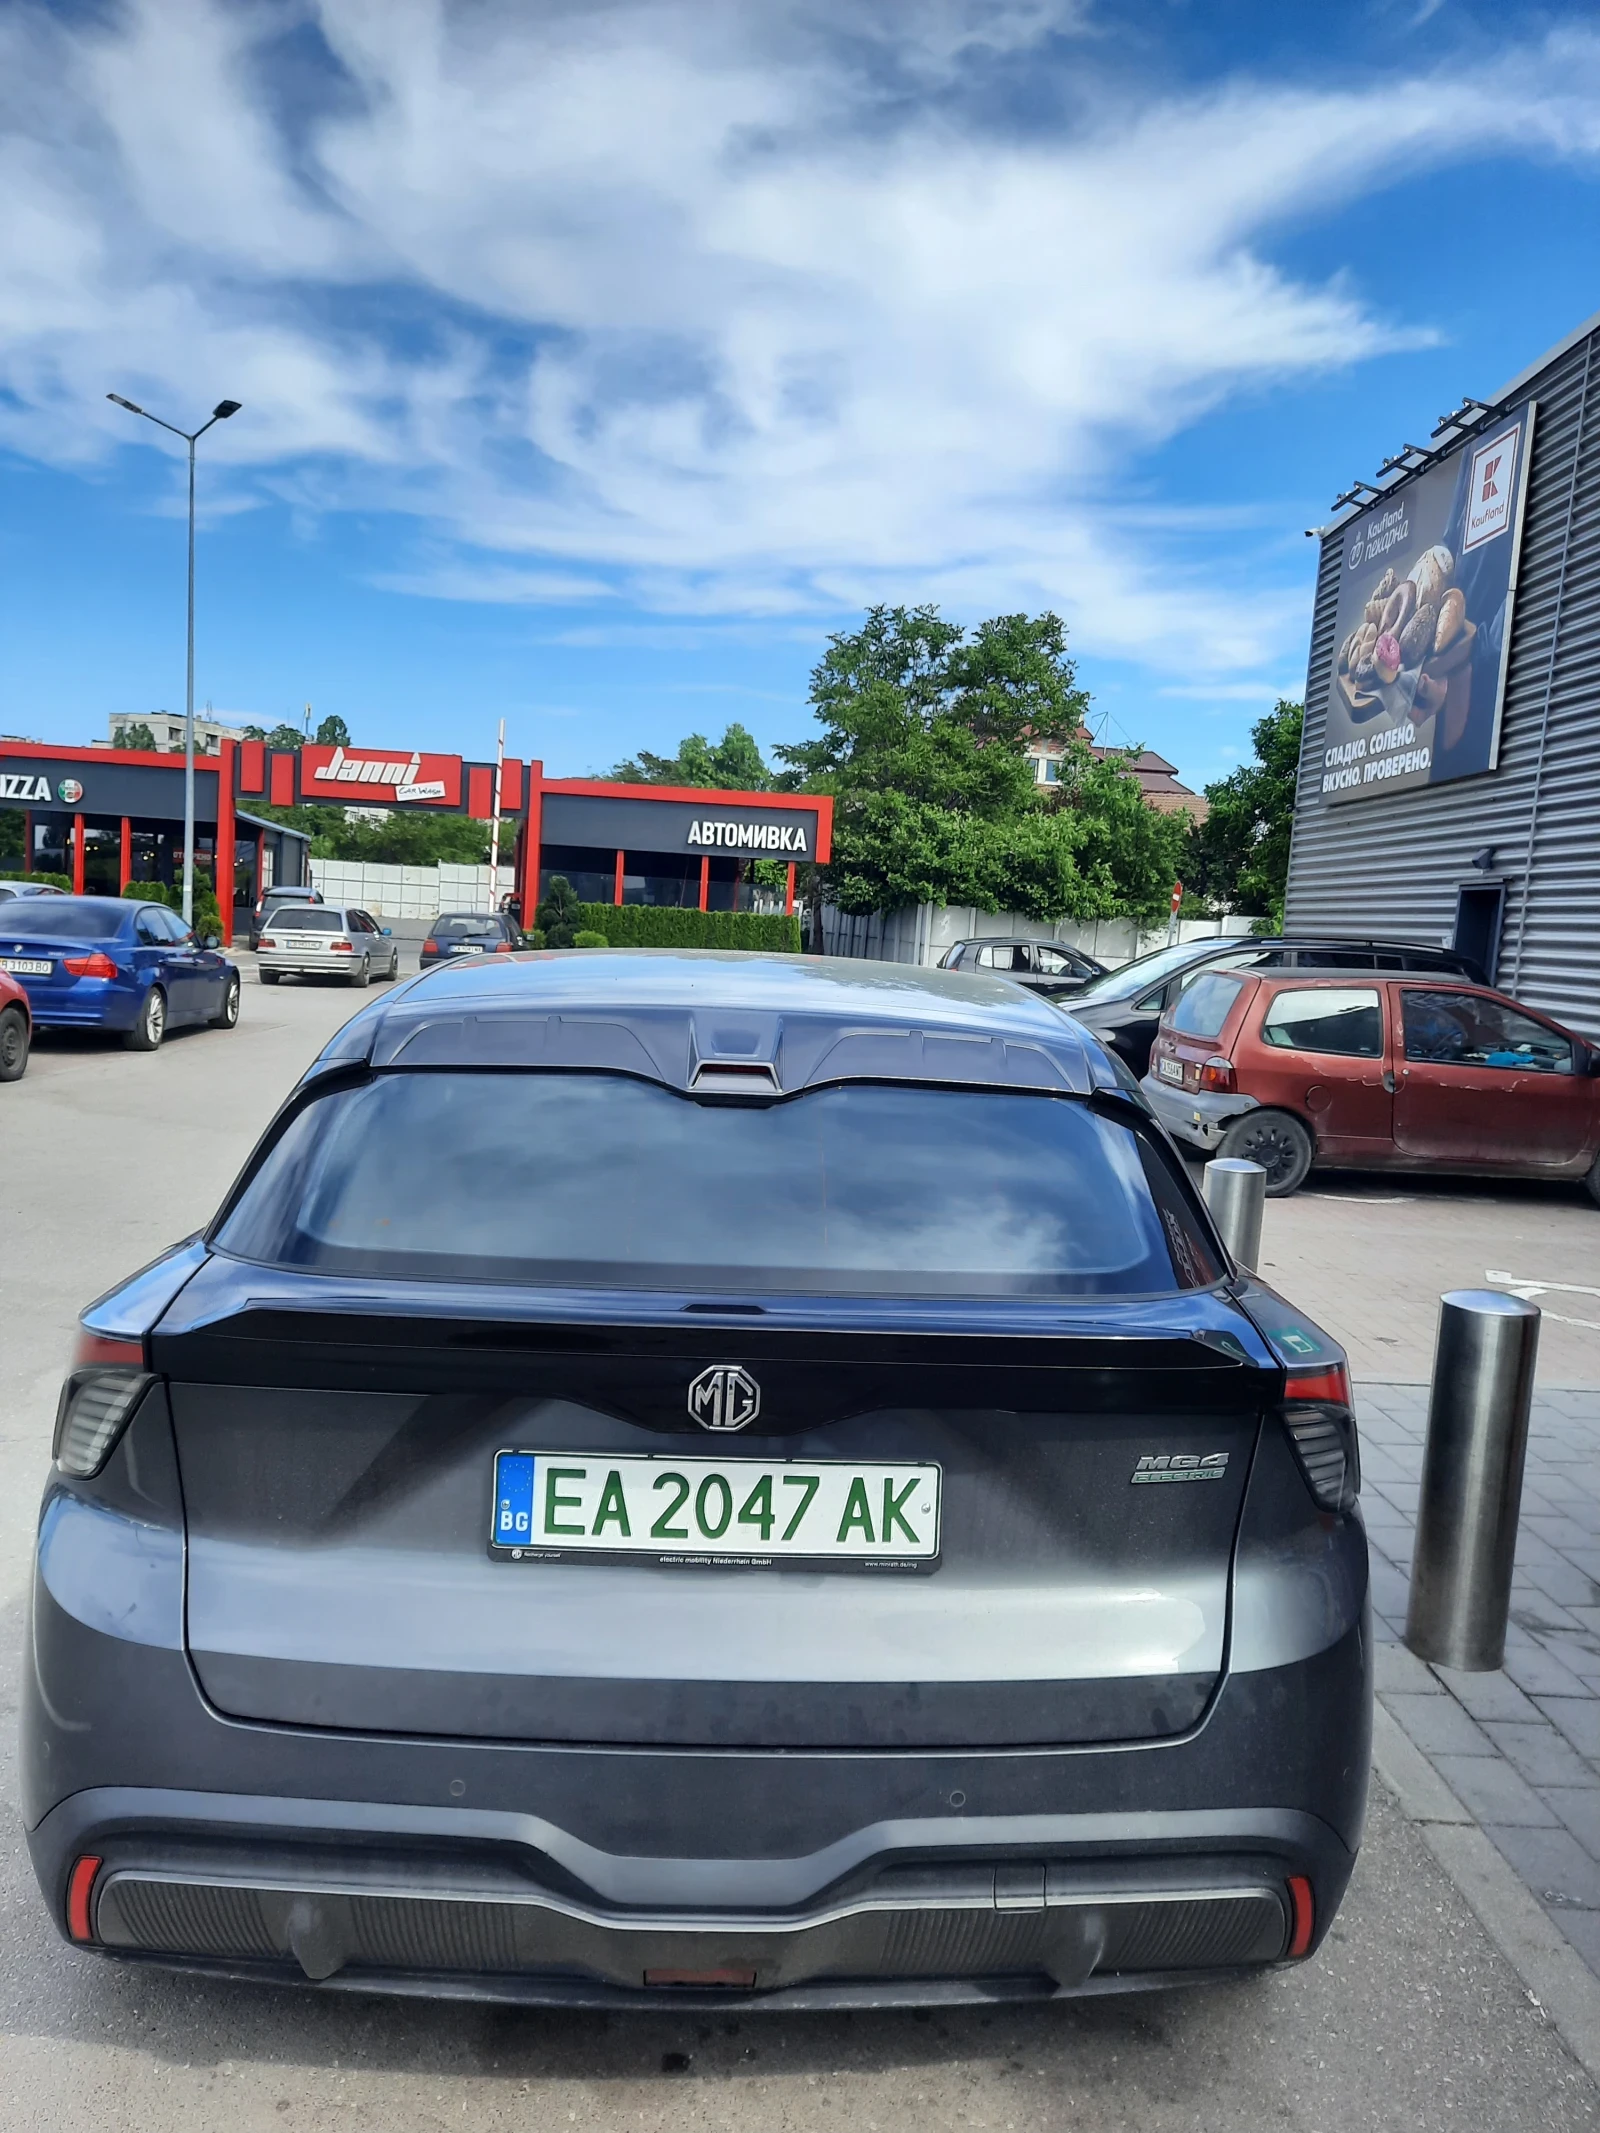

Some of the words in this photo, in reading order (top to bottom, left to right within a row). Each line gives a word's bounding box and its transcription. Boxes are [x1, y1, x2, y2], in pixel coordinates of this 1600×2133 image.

[1367, 501, 1405, 540] Kaufland
[1471, 500, 1505, 530] Kaufland
[1325, 738, 1368, 768] СЛАДКО.
[1369, 723, 1416, 755] СОЛЕНО.
[314, 746, 421, 785] Janni
[1322, 766, 1361, 793] ВКУСНО.
[1363, 747, 1432, 783] ПРОВЕРЕНО.
[687, 821, 807, 851] АВТОМИВКА
[695, 1372, 754, 1426] MG
[1135, 1469, 1223, 1482] ELECTRIC
[1136, 1453, 1229, 1470] MG4
[500, 1511, 528, 1531] BG
[544, 1467, 631, 1537] EA
[650, 1472, 820, 1541] 2047
[836, 1476, 922, 1543] AK
[685, 1557, 711, 1565] mobility
